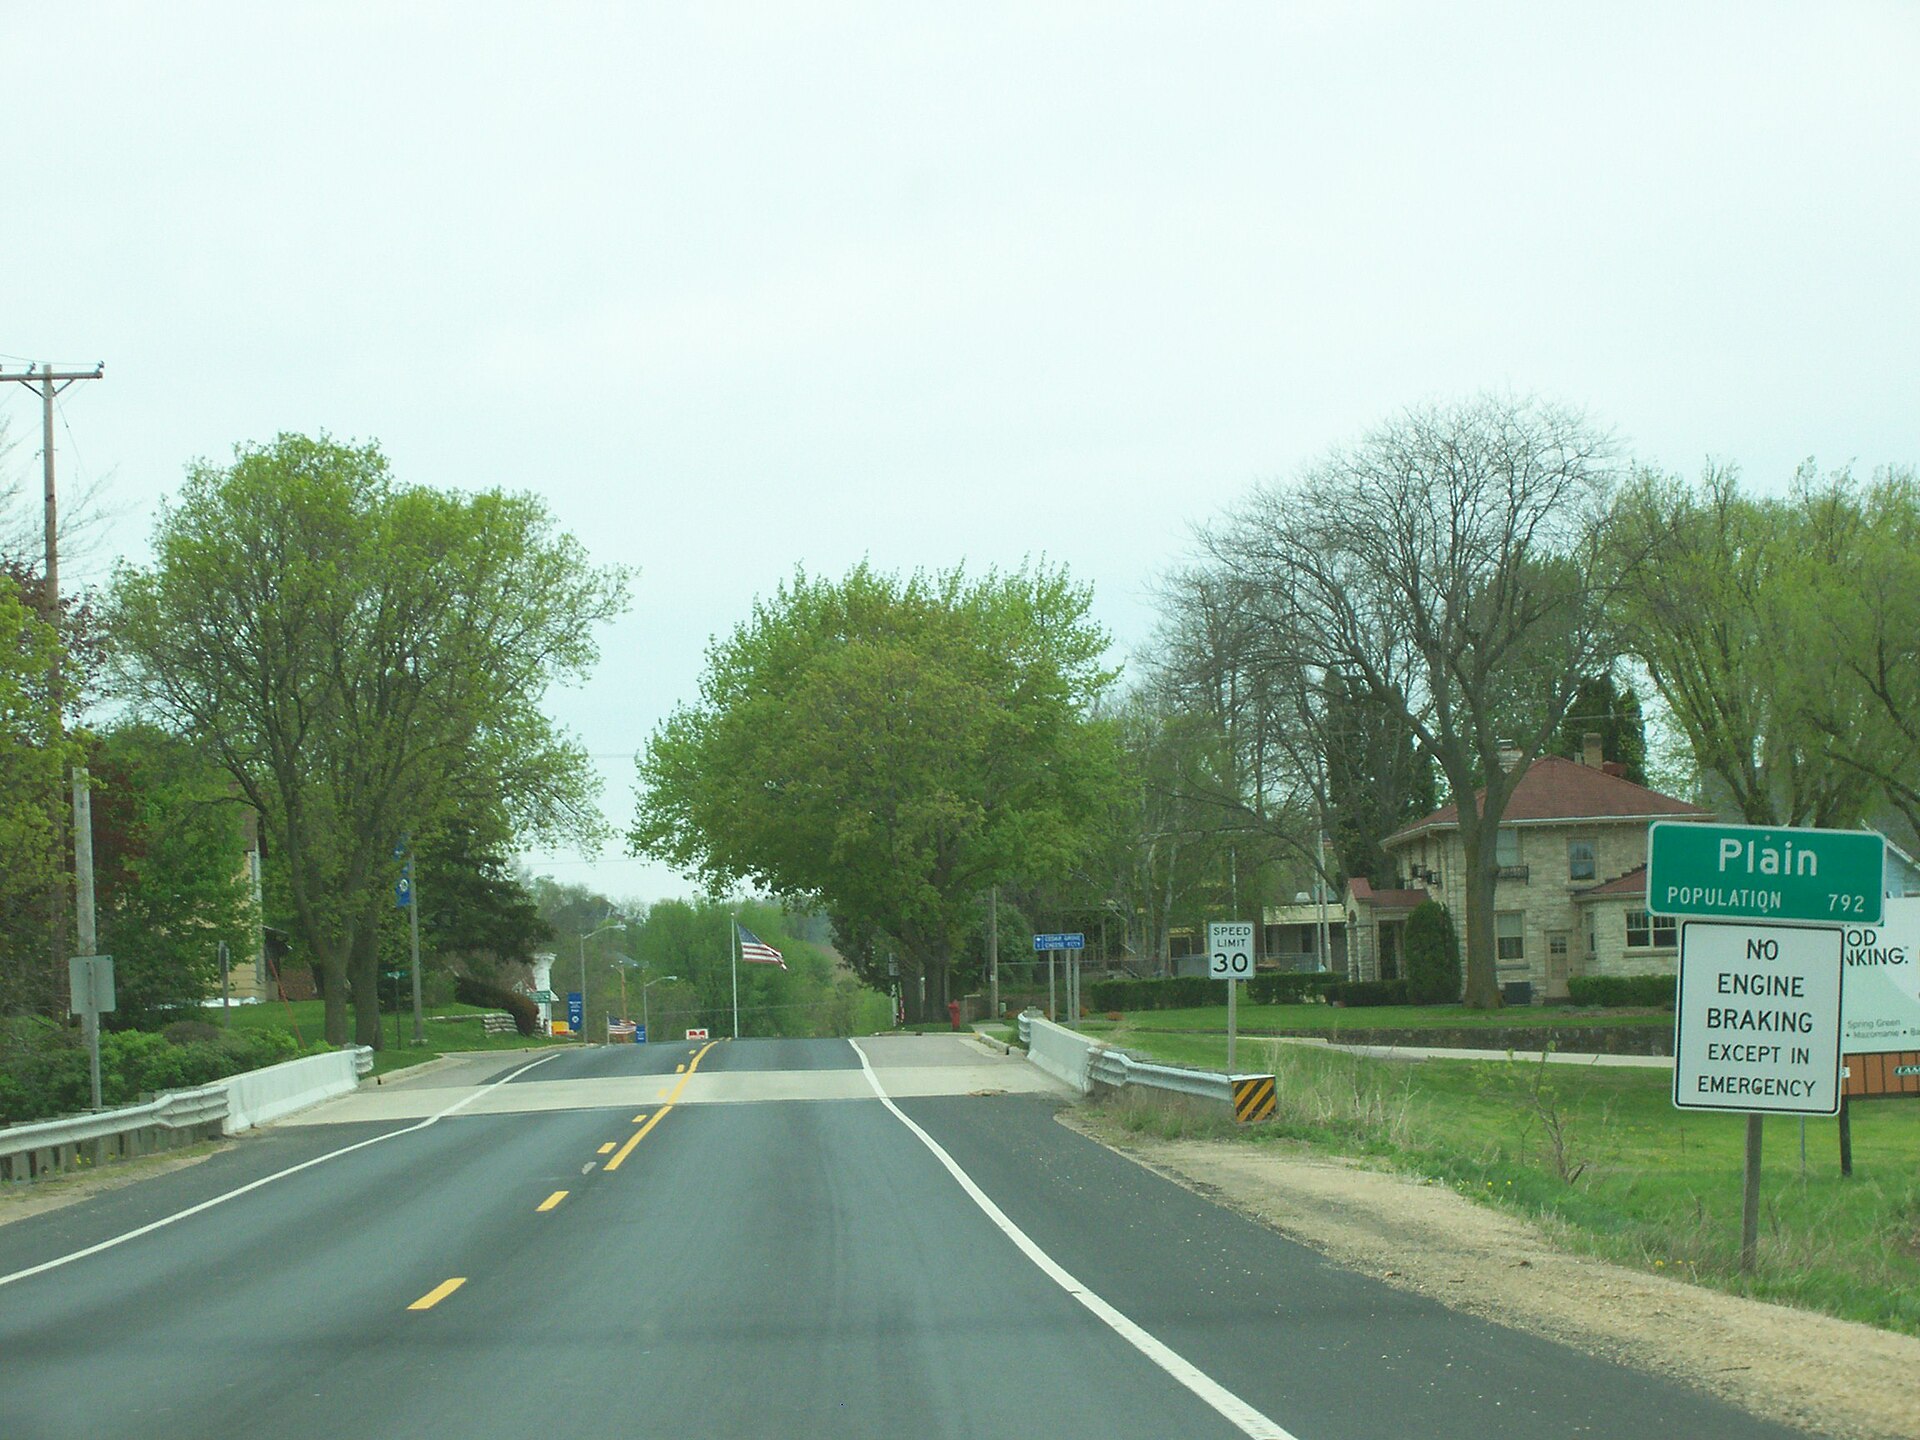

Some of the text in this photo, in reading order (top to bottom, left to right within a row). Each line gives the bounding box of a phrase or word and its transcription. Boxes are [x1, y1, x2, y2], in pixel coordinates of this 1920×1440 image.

[1718, 837, 1818, 877] Plain
[1668, 886, 1865, 913] POPULATION 792
[1213, 926, 1251, 936] SPEED
[1217, 938, 1246, 948] LIMIT
[1746, 938, 1779, 961] NO
[1213, 952, 1248, 973] 30
[1717, 972, 1805, 998] ENGINE
[1706, 1007, 1813, 1034] BRAKING
[1708, 1043, 1810, 1065] EXCEPT IN
[1697, 1075, 1816, 1097] EMERGENCY
